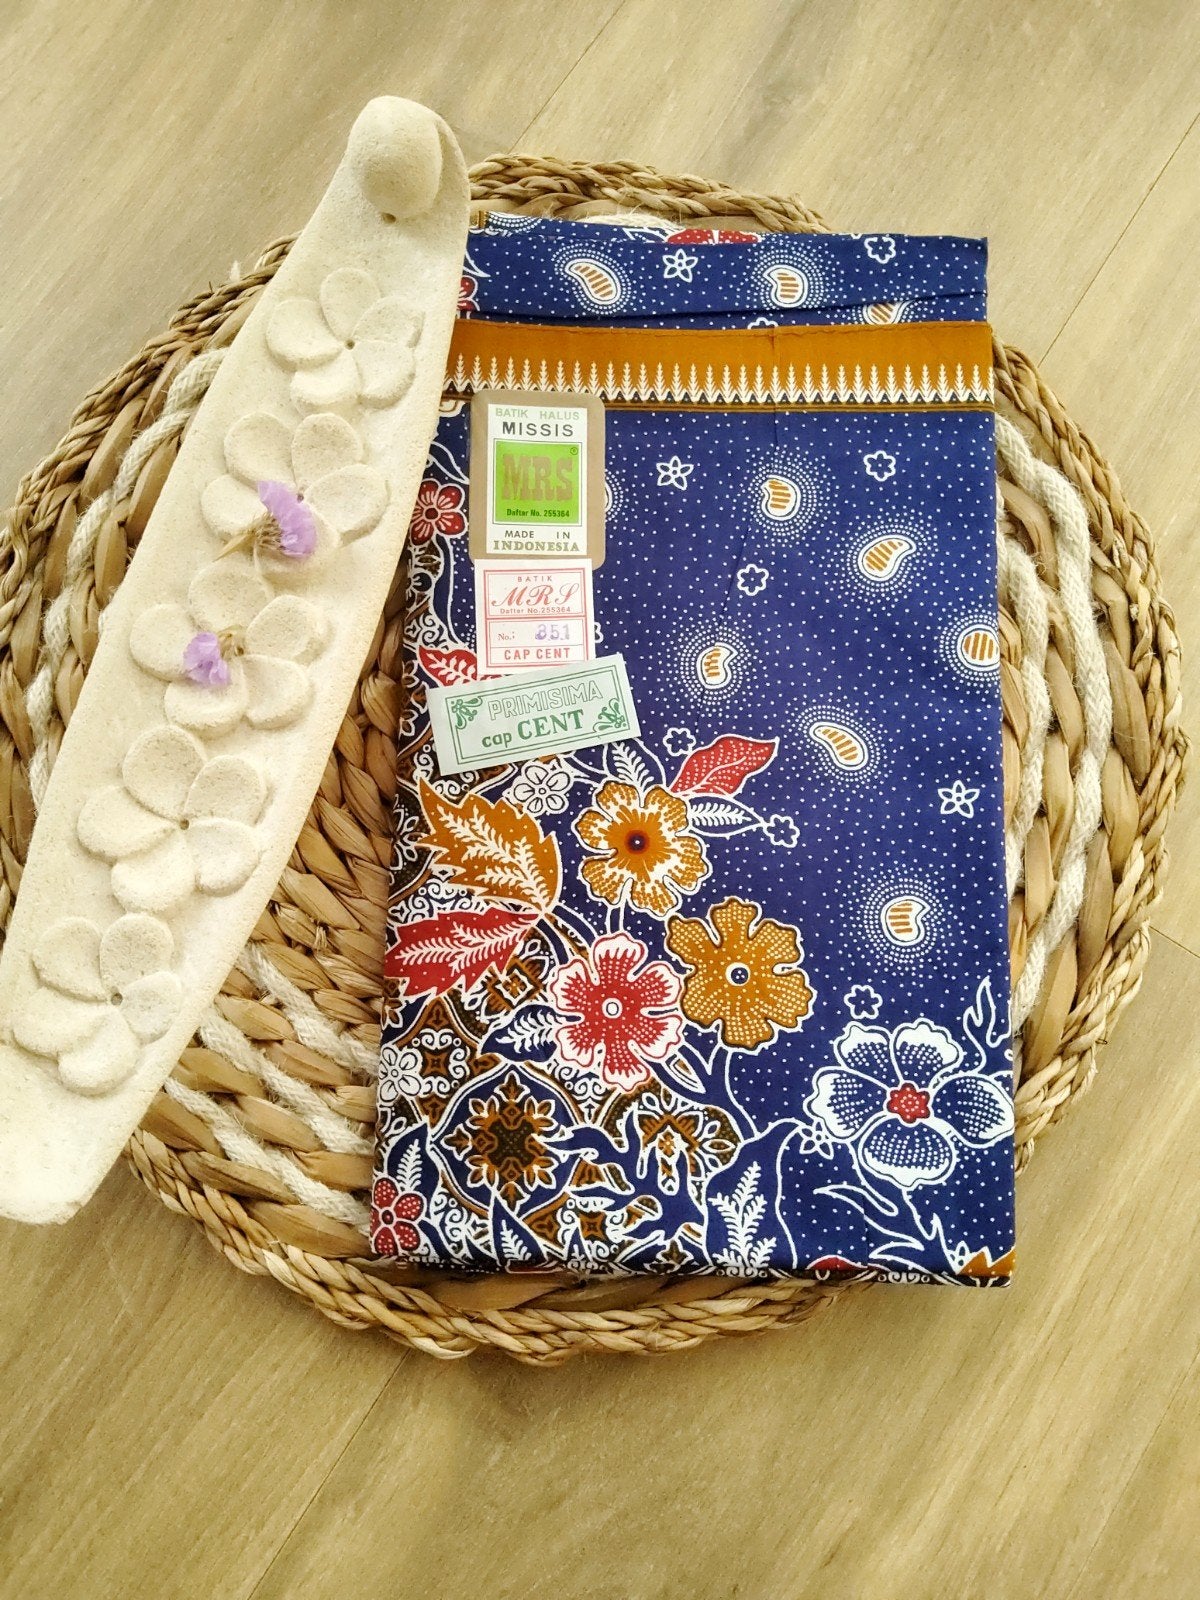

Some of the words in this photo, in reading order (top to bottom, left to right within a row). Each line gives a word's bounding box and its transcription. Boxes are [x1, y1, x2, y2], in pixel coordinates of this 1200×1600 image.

[495, 407, 529, 418] BATIK
[539, 410, 580, 421] HALUS
[502, 421, 574, 437] MISSIS
[501, 453, 573, 502] MRS
[530, 509, 542, 517] No.
[543, 509, 570, 518] 255364
[504, 530, 535, 539] MADE
[556, 531, 571, 539] IN
[493, 540, 580, 552] INDONESIA
[517, 575, 553, 583] BATIK
[491, 582, 580, 607] MRS
[504, 649, 531, 661] CAP
[536, 647, 571, 660] CENT
[487, 680, 604, 721] PRIMISIMA
[481, 732, 513, 749] cap
[517, 708, 585, 741] CENT
